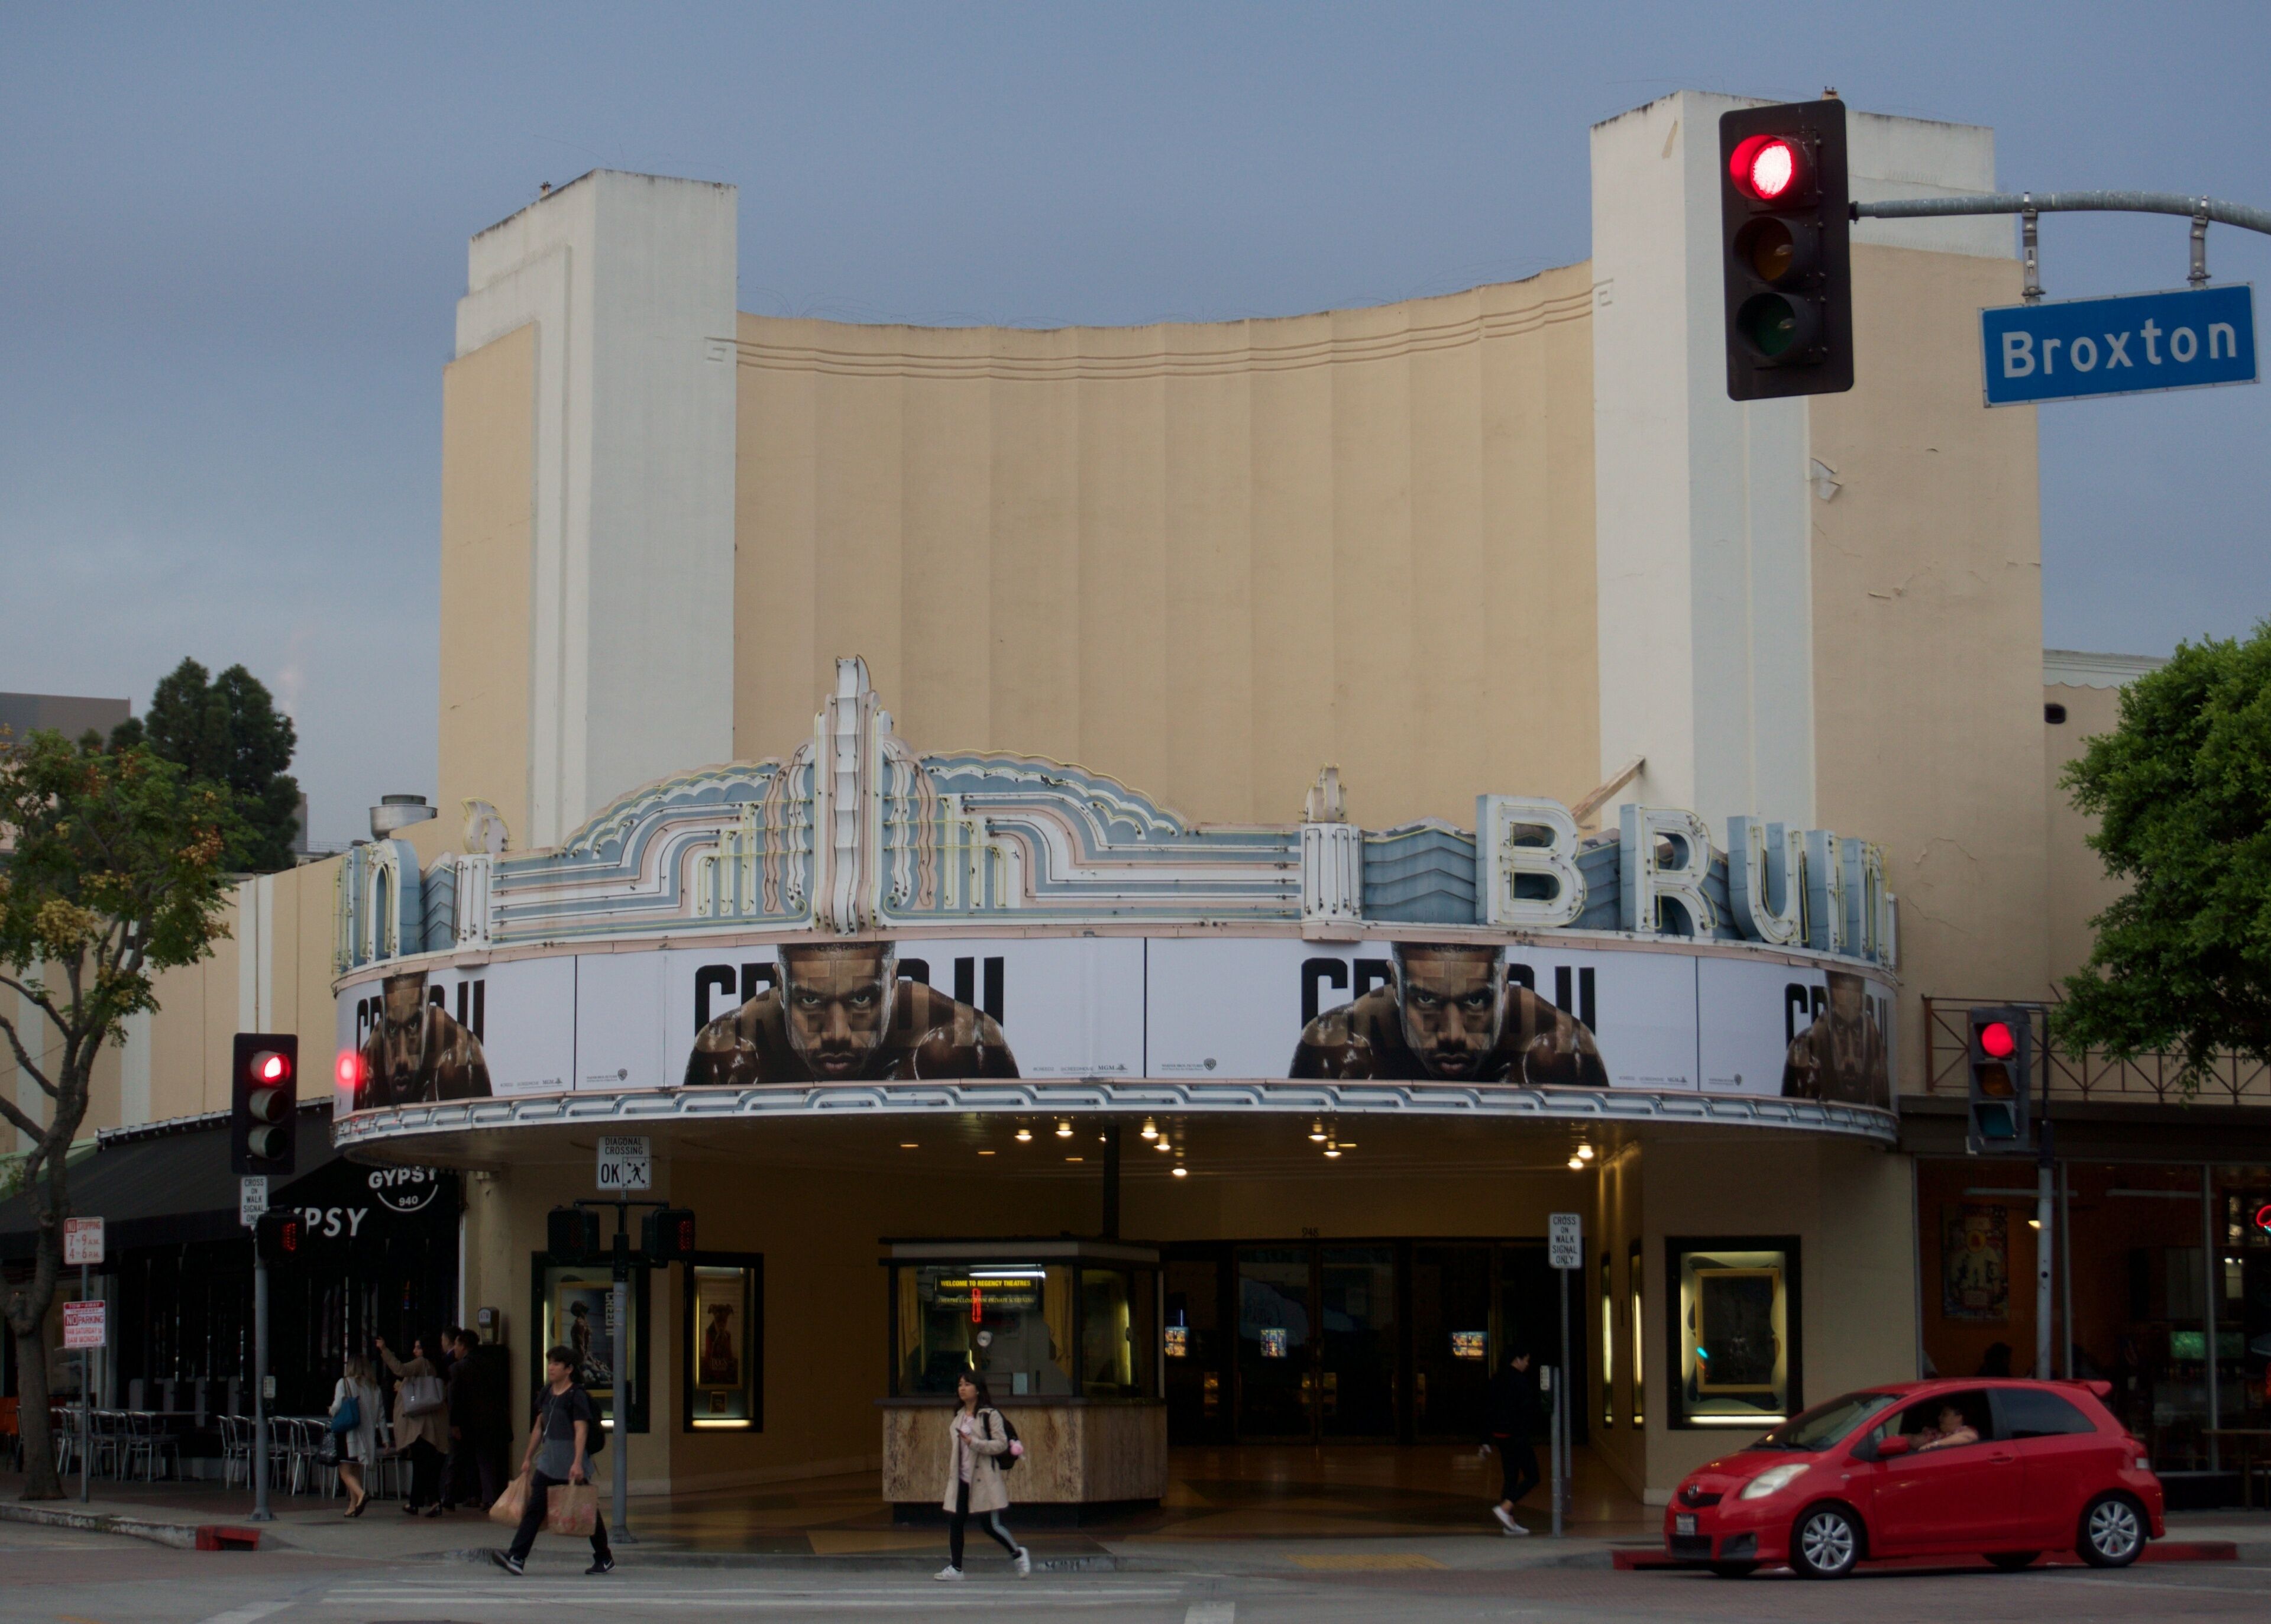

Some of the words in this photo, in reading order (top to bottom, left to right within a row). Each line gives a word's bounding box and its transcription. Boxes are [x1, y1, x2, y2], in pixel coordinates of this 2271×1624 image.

[2002, 318, 2236, 378] Broxton
[1476, 794, 1888, 964] BRUIN
[605, 1137, 642, 1146] DIAGONAL
[605, 1146, 643, 1154] CROSSING
[368, 1166, 438, 1189] GYPSY
[601, 1163, 619, 1183] OK
[244, 1178, 264, 1187] CROSS
[246, 1195, 262, 1204] WALK
[399, 1195, 419, 1207] 940
[1552, 1216, 1576, 1225] CROSS
[67, 1221, 76, 1232] NO
[77, 1221, 101, 1230] STOPPING
[1555, 1235, 1574, 1243] WALK
[1552, 1245, 1577, 1254] SIGNAL
[1555, 1255, 1573, 1264] ONLY
[67, 1315, 78, 1325] NO
[78, 1315, 104, 1324] PARKING
